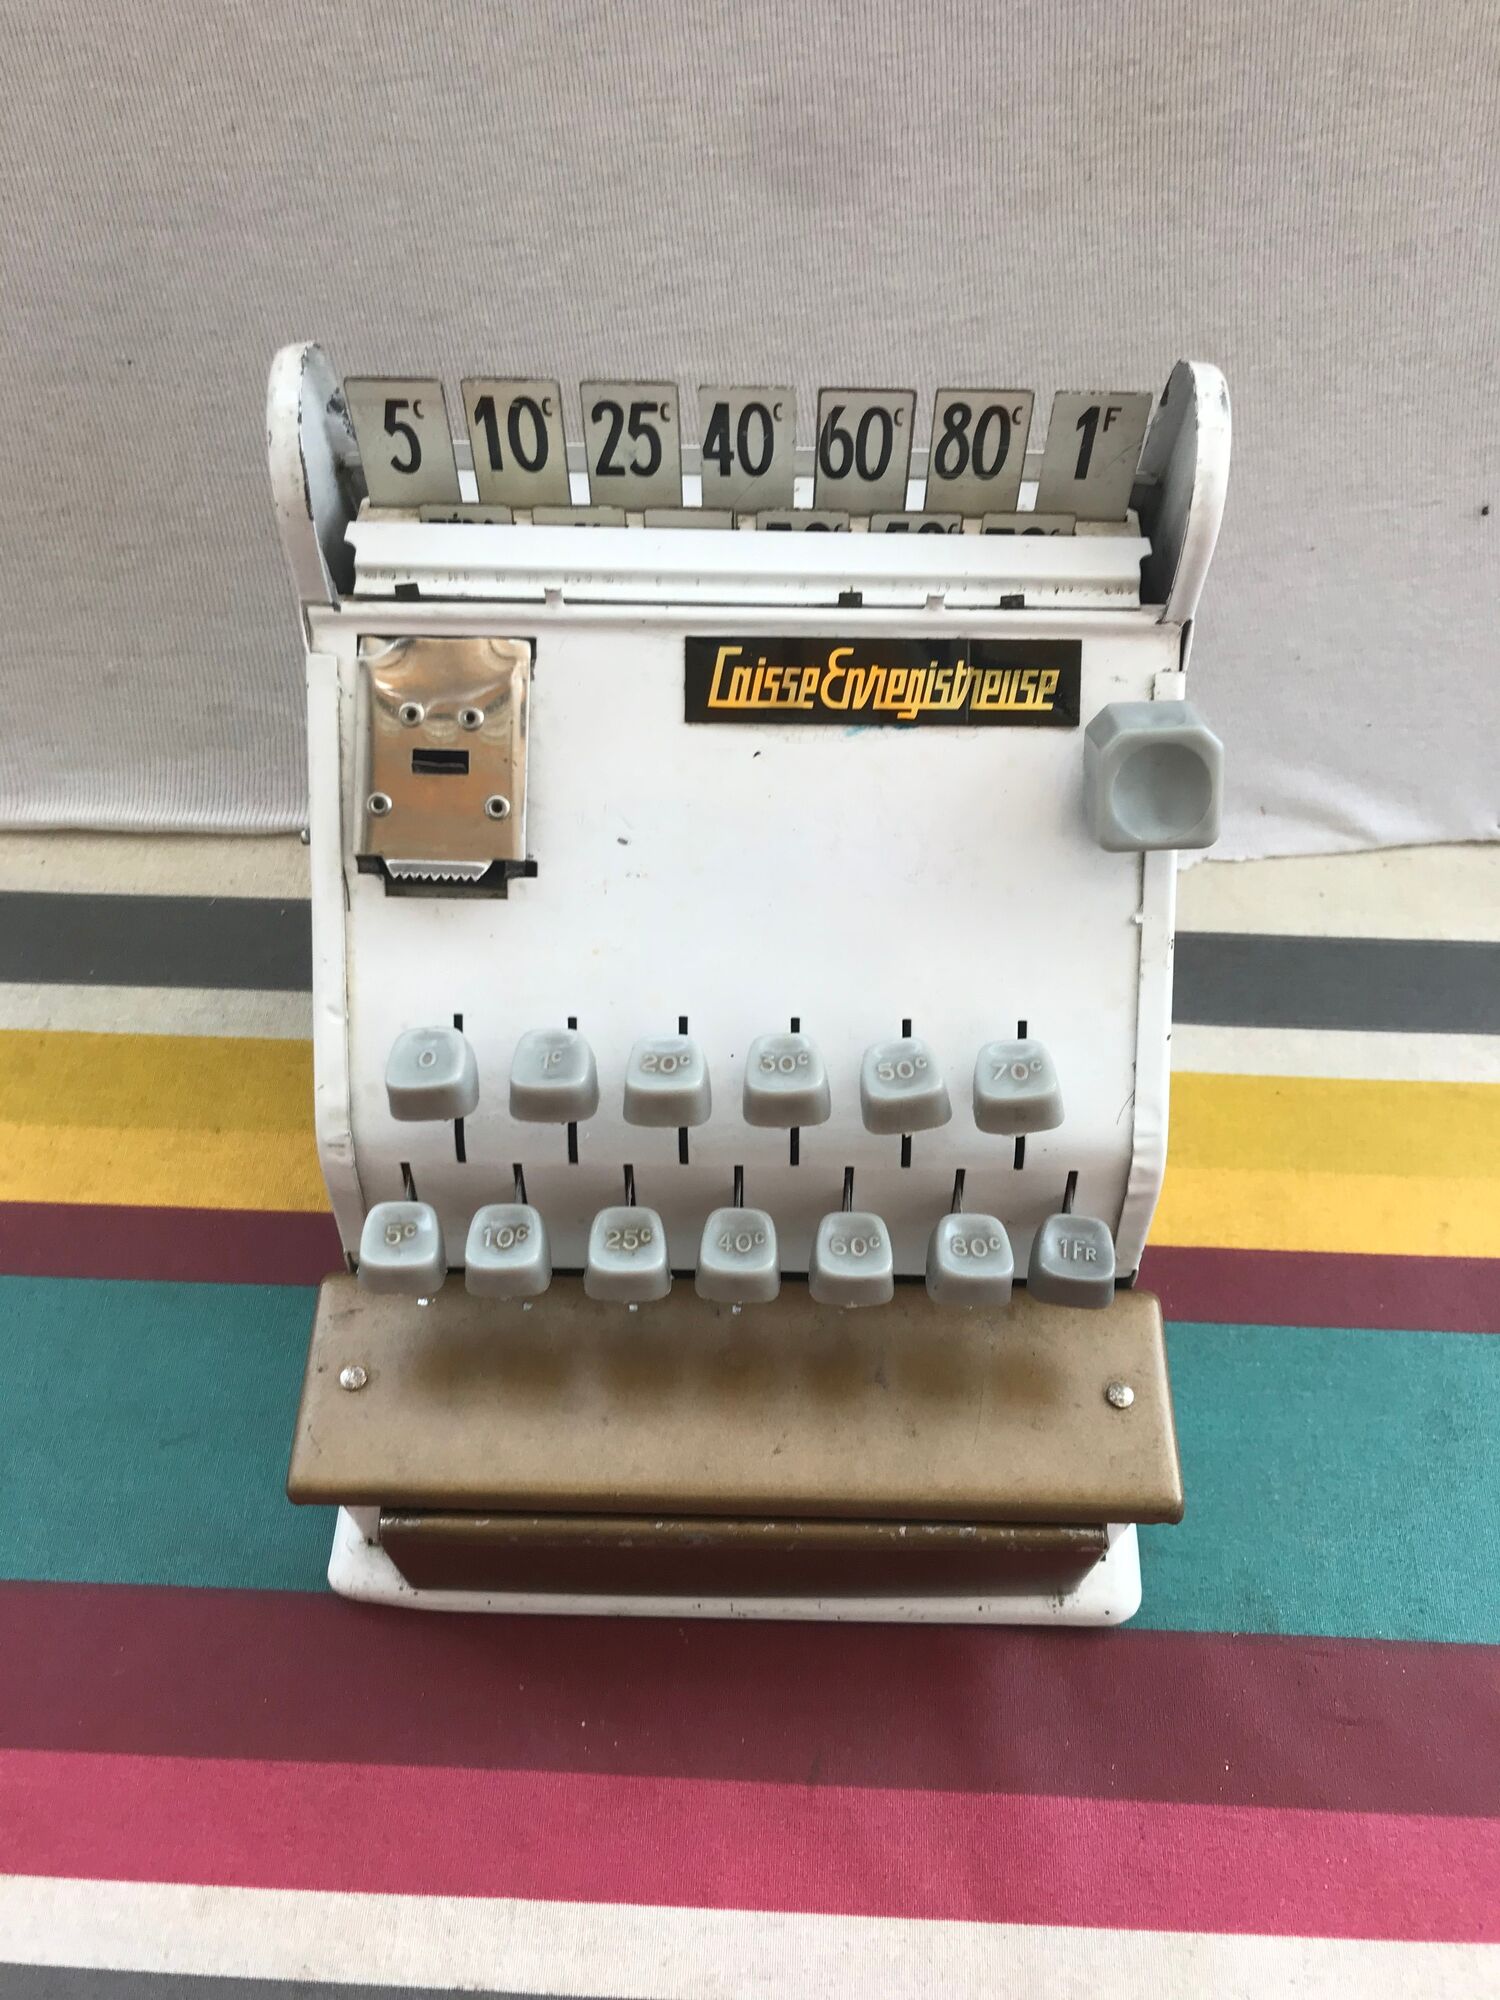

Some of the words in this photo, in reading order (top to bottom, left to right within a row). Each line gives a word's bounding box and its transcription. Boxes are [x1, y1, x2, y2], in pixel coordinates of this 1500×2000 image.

[1074, 406, 1122, 480] 1F
[820, 647, 1060, 721] Enregistreuse
[419, 1050, 437, 1068] 0
